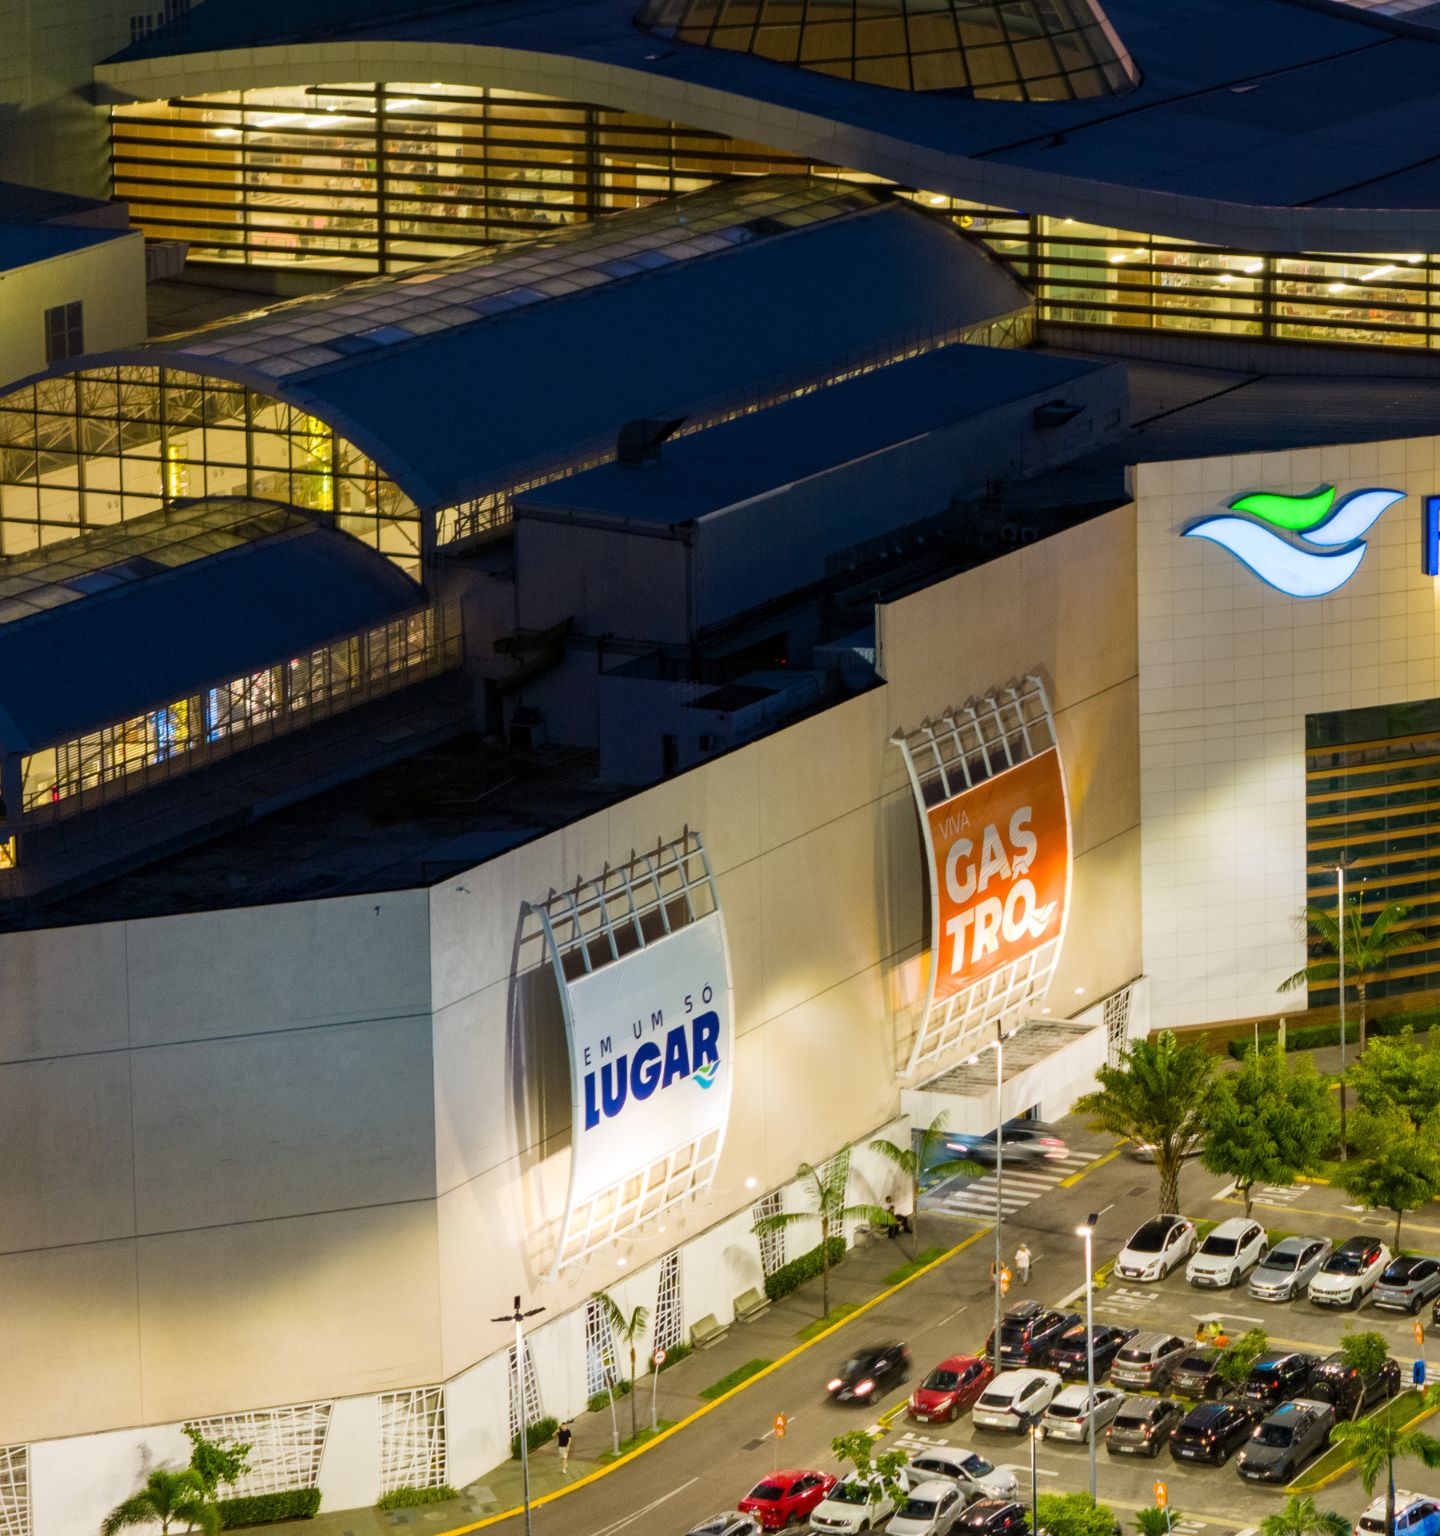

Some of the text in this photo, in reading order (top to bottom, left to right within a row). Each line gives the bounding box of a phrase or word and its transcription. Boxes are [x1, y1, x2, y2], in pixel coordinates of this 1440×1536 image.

[939, 810, 970, 841] VIVA
[584, 982, 713, 1066] EM UM SÓ
[584, 1010, 720, 1132] LUGAR
